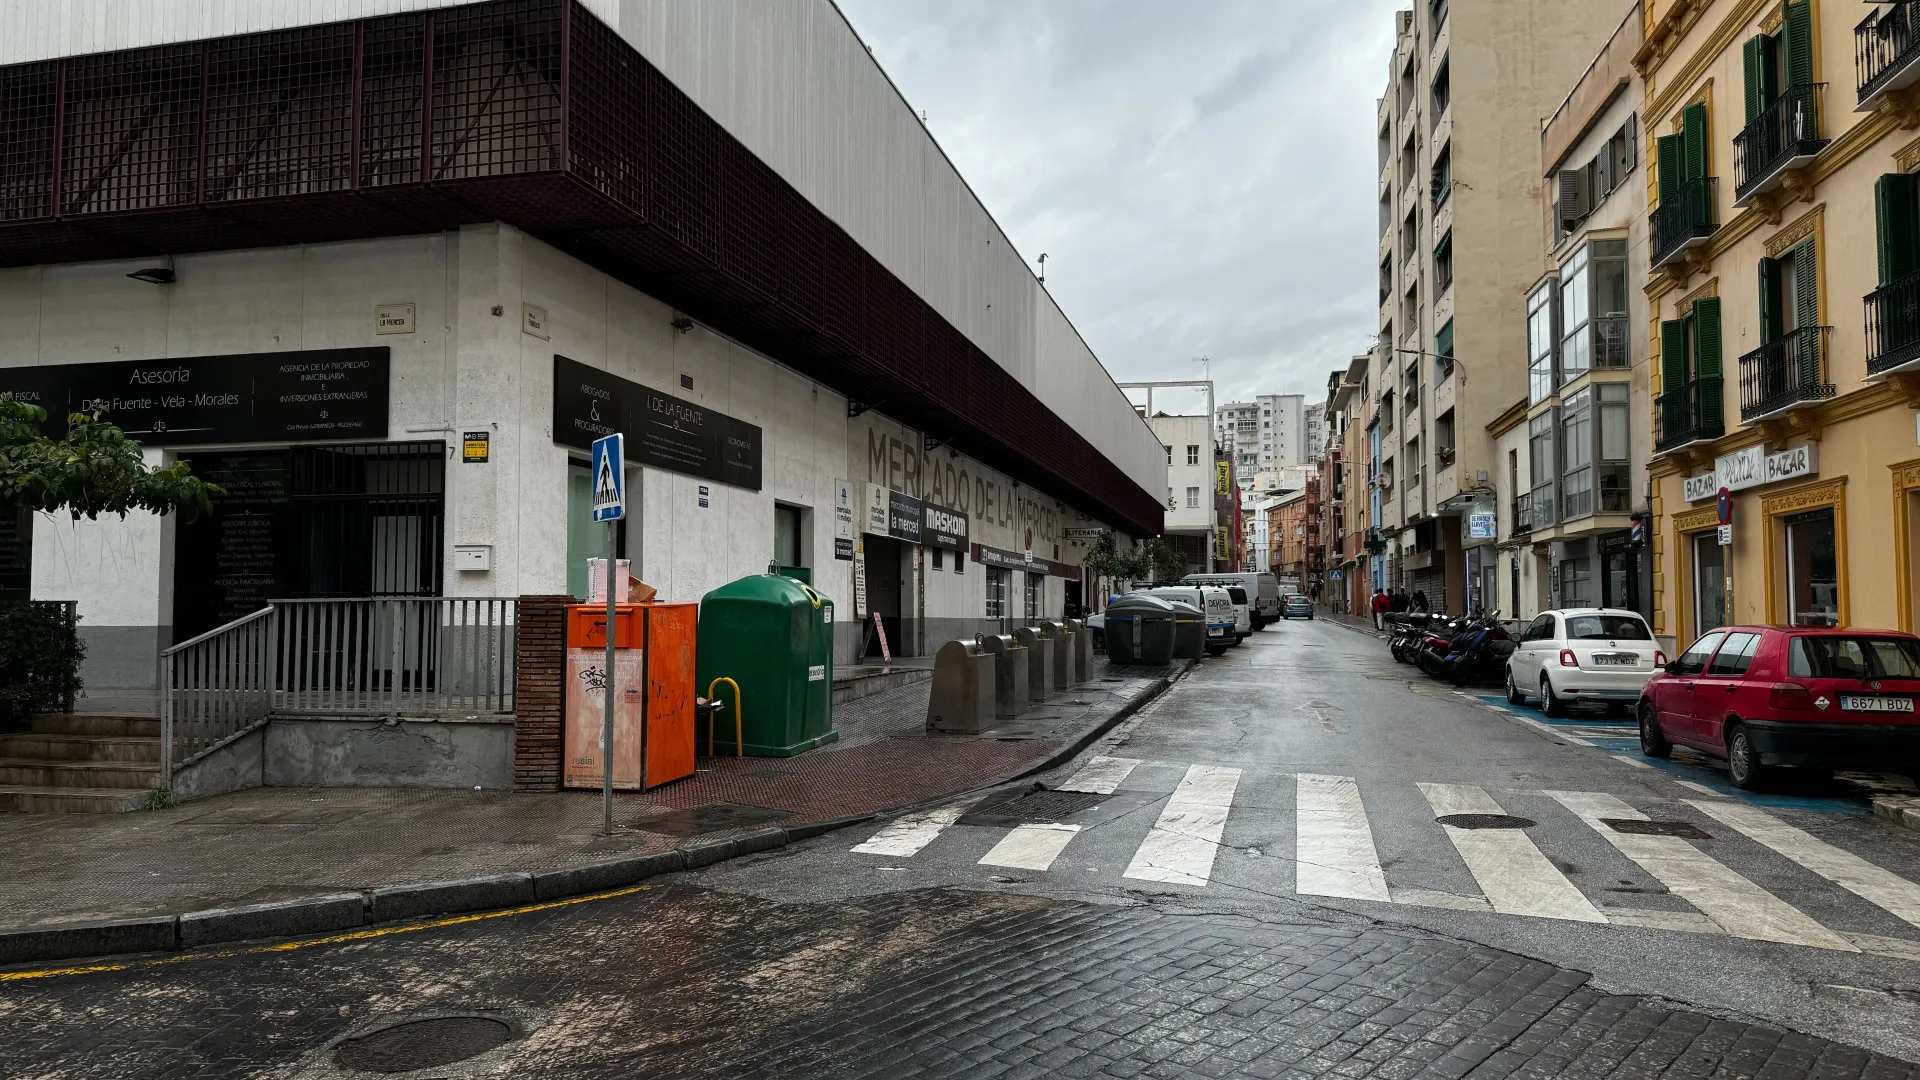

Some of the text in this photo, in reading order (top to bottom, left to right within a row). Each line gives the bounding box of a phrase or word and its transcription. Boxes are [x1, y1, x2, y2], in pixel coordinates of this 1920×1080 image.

[129, 365, 190, 384] Asesoría
[278, 360, 370, 373] AGENCIA DE LA PROPIEDAD
[300, 372, 345, 381] INMOBILIARIA
[15, 391, 41, 401] FISCAL
[321, 383, 326, 391] E
[580, 383, 611, 401] ABOGADOS
[82, 399, 98, 412] De
[112, 397, 151, 410] Fuente
[161, 396, 185, 408] Vela
[194, 392, 239, 407] Morales
[279, 391, 368, 403] INVERSIONES EXTRANJERAS
[591, 399, 601, 422] &
[652, 397, 664, 414] DE
[665, 400, 675, 416] LA
[676, 405, 703, 426] FUENTE
[1769, 450, 1806, 479] BAZAR
[868, 426, 1058, 543] MERCADO DE LA MERCED
[1686, 475, 1714, 499] BAZAR
[891, 512, 919, 534] la merced
[926, 507, 966, 537] MASKOM
[1851, 698, 1882, 709] 6671
[1887, 699, 1912, 710] BDZ
